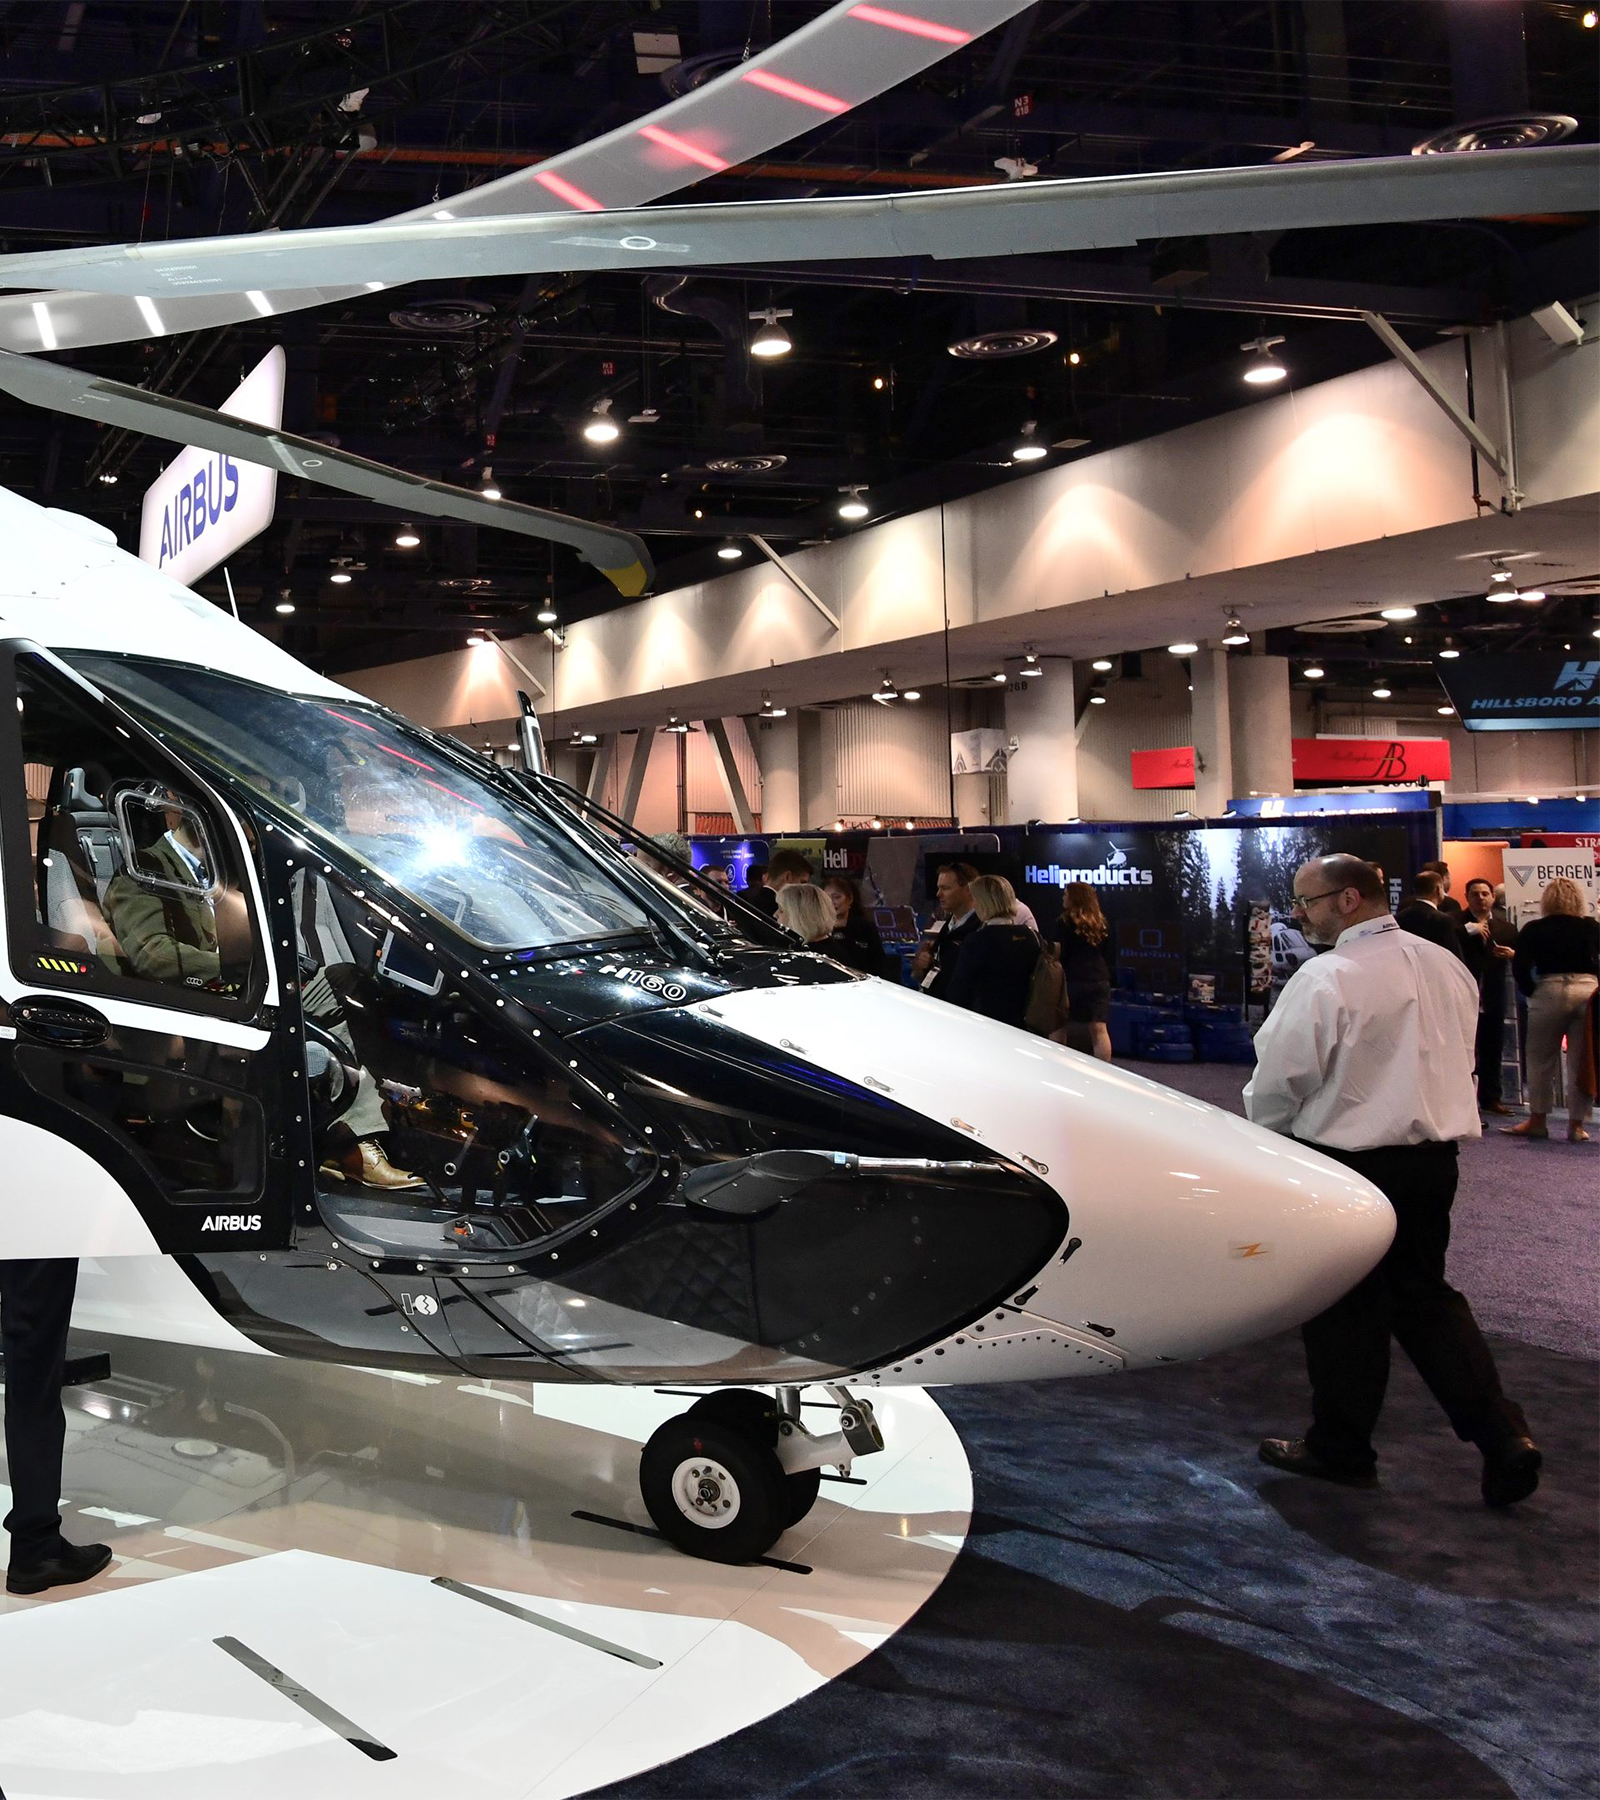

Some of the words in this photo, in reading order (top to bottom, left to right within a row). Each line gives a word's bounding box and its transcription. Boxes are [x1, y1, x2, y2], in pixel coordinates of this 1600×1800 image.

[1014, 95, 1029, 108] N3
[1014, 105, 1029, 117] 418
[159, 454, 239, 569] AIRBUS
[1471, 696, 1582, 709] HILLSBORO
[1025, 865, 1153, 888] Heliproducts
[1537, 865, 1593, 879] BERGEN
[598, 965, 687, 1001] H160
[201, 1215, 262, 1231] AIRBUS
